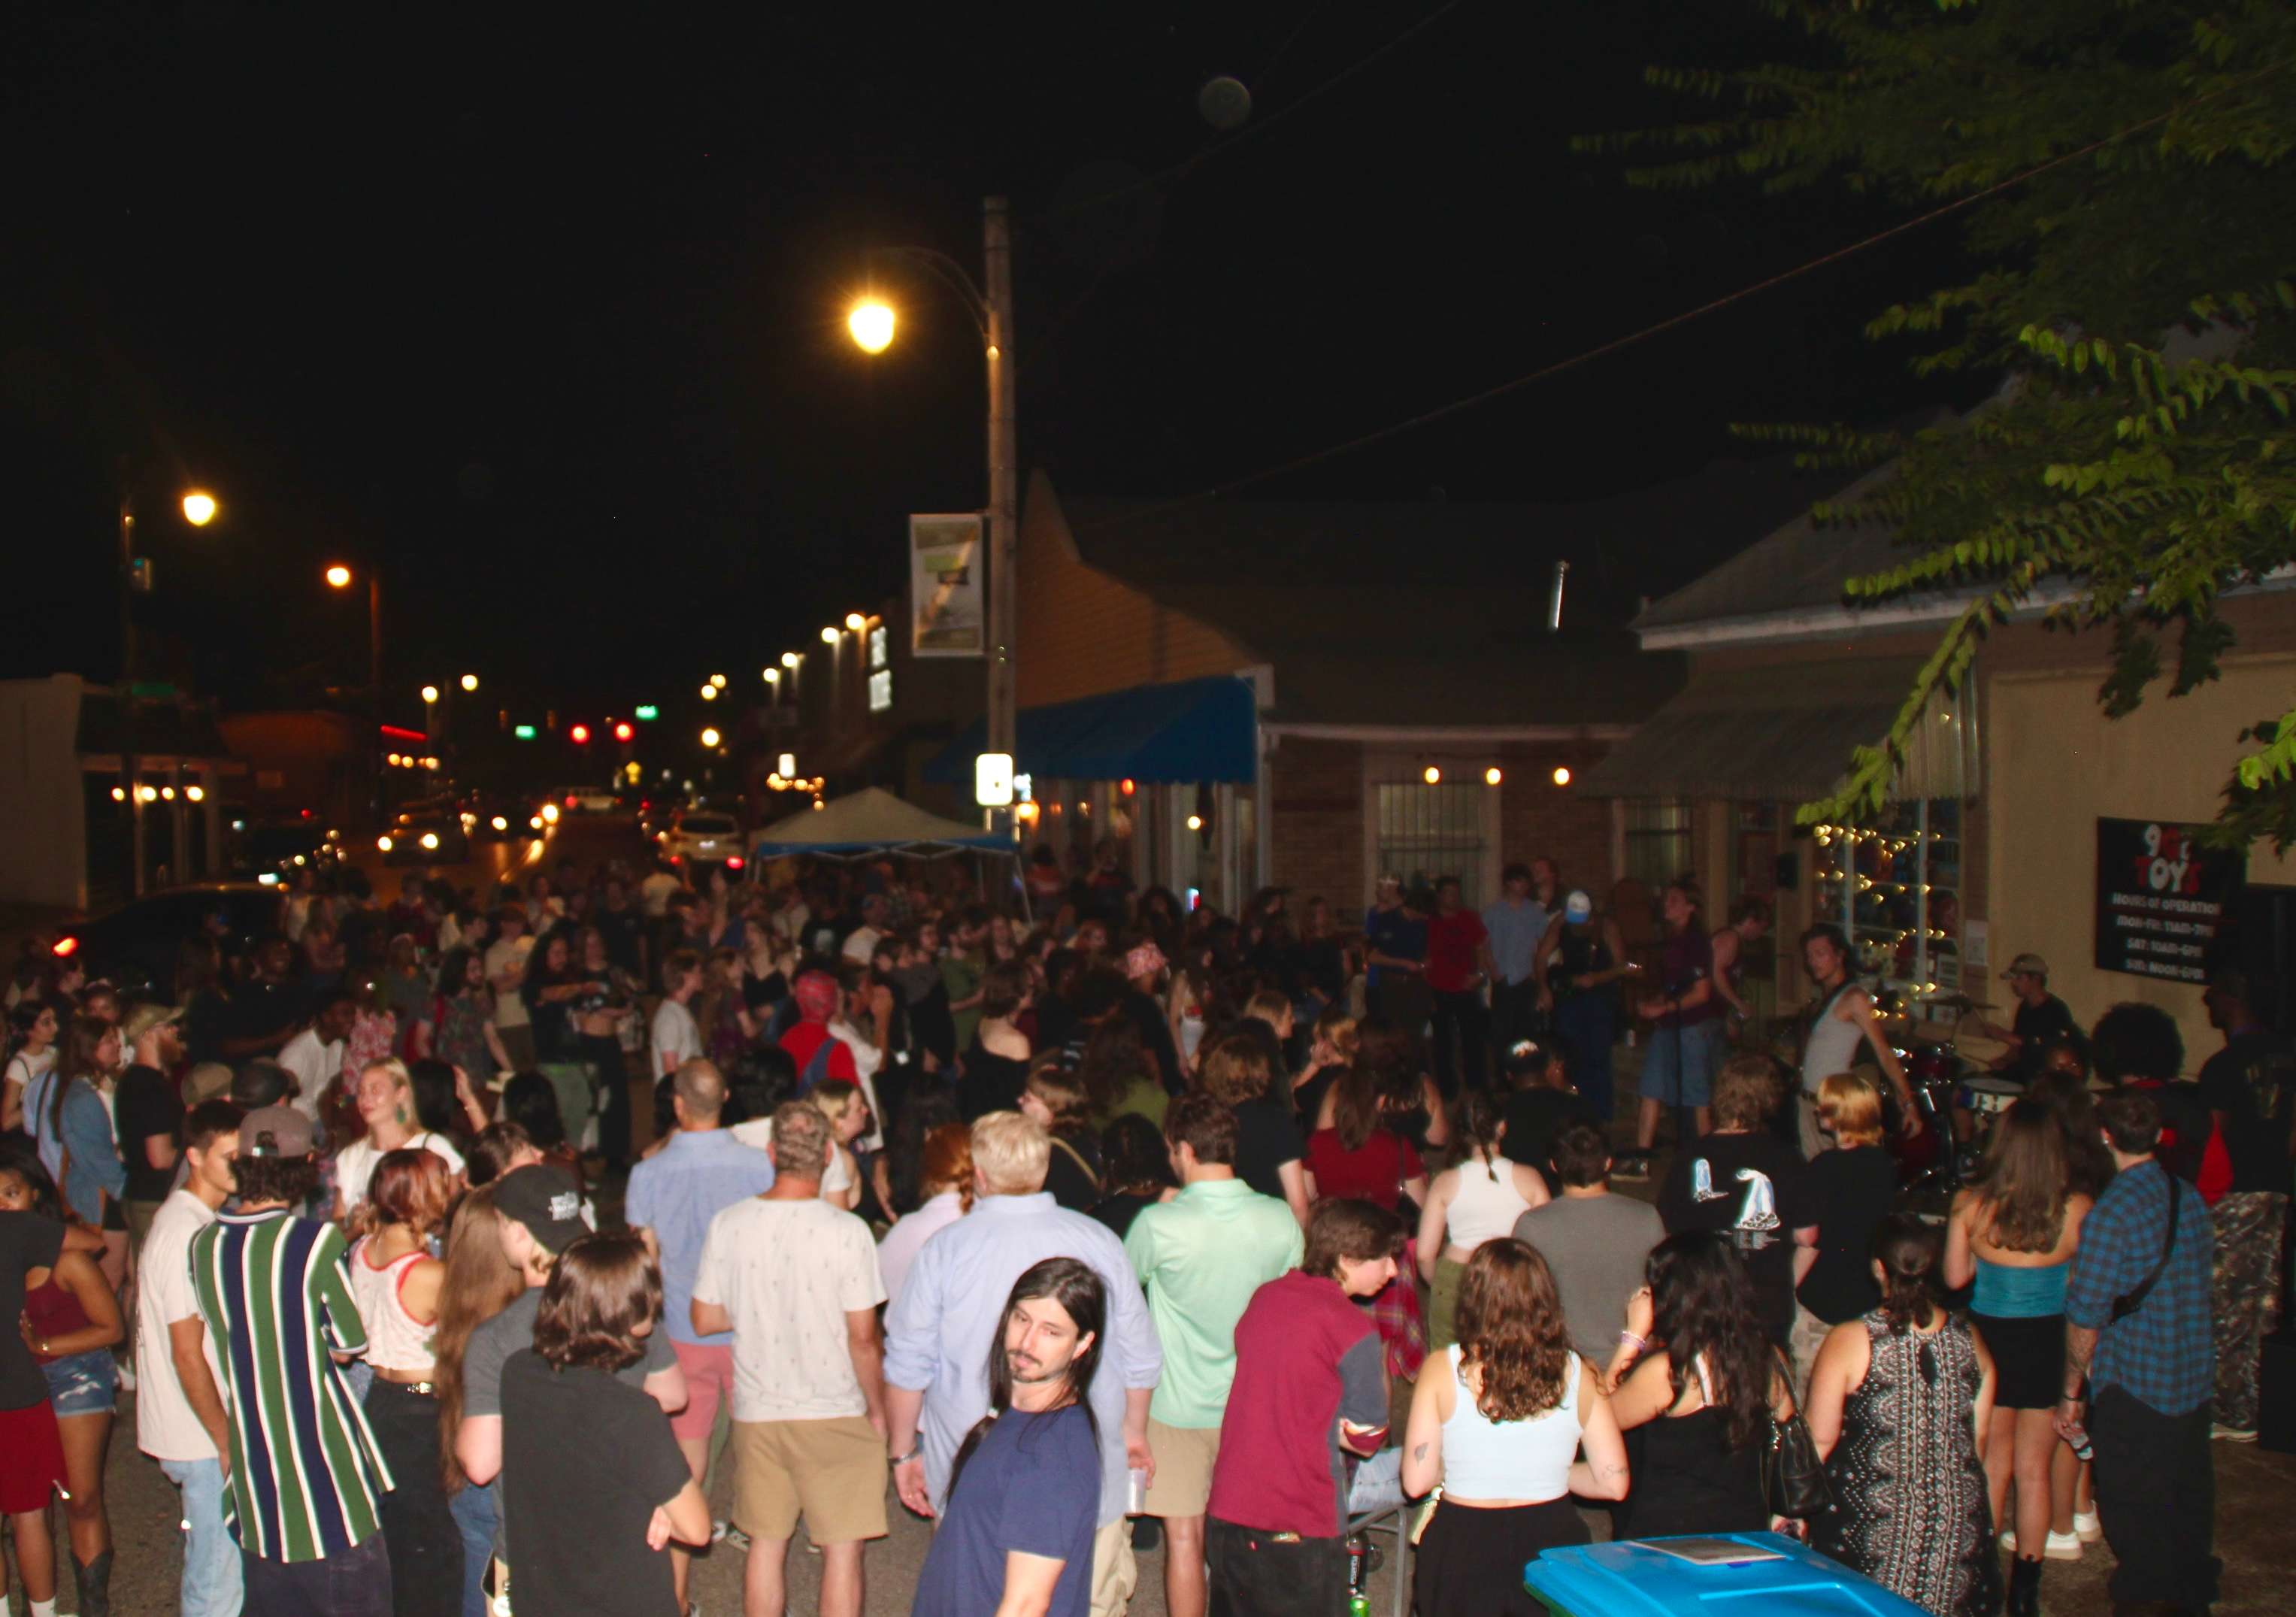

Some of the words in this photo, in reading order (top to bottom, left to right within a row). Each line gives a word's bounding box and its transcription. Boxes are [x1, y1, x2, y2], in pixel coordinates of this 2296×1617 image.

[2134, 855, 2202, 895] TOYS
[2112, 892, 2147, 907] HOURS
[2148, 897, 2161, 909] OF
[2162, 898, 2222, 915] OPERATION
